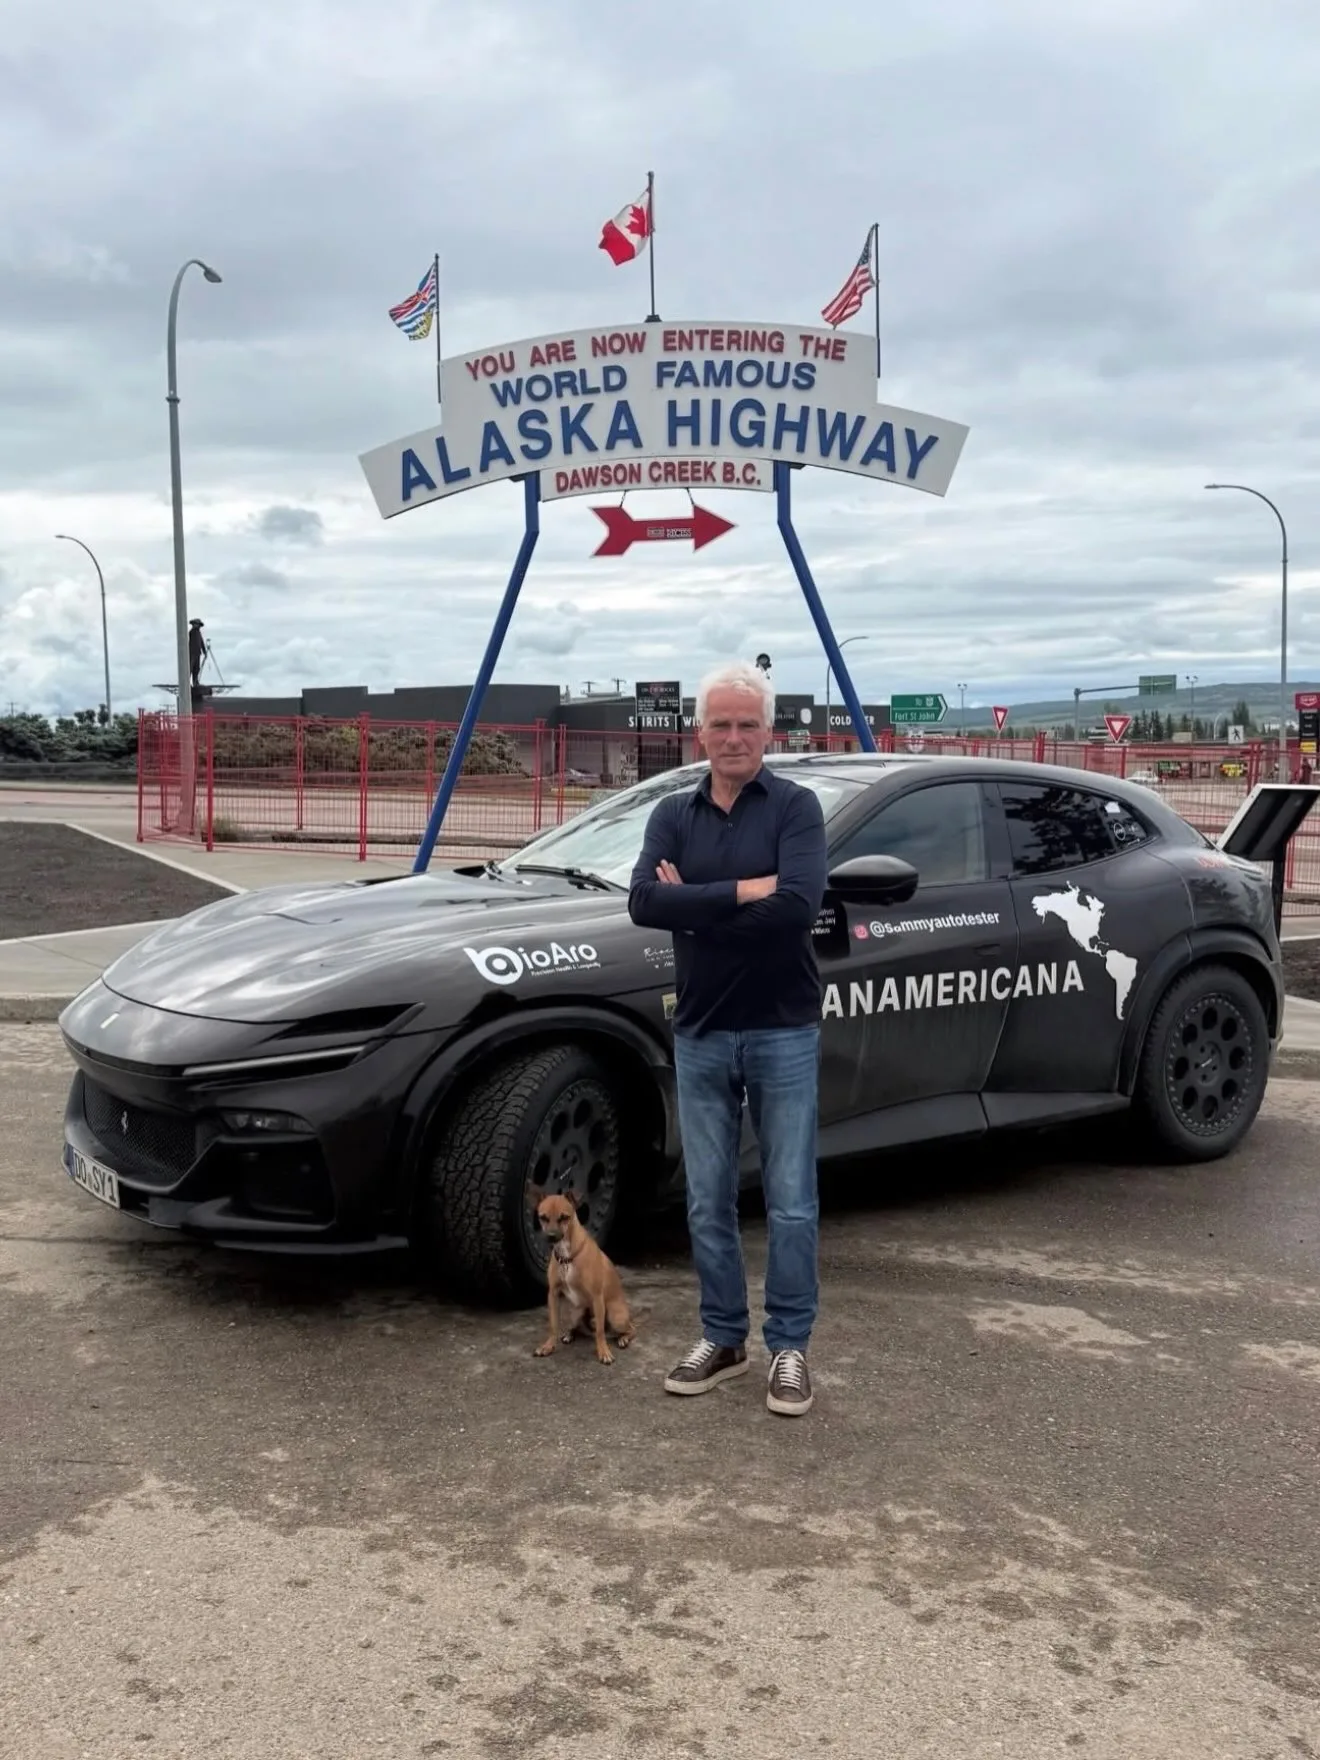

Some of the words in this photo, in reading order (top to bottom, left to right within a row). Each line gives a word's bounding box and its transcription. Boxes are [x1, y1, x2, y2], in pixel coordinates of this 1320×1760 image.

[465, 350, 516, 381] YOU
[529, 339, 577, 368] ARE
[591, 331, 647, 358] NOW
[662, 329, 785, 353] ENTERING
[799, 334, 847, 361] THE
[490, 365, 628, 408] WORLD
[656, 359, 816, 390] FAMOUS
[401, 399, 643, 501] ALASKA
[667, 398, 939, 480] HIGHWAY
[555, 462, 642, 493] DAWSON
[648, 461, 717, 484] CREEK
[723, 462, 762, 485] B.C.
[830, 716, 852, 726] COLD
[869, 912, 1000, 938] @sammyautotester
[821, 960, 1085, 1020] ANAMERICANA
[75, 1153, 87, 1184] DO
